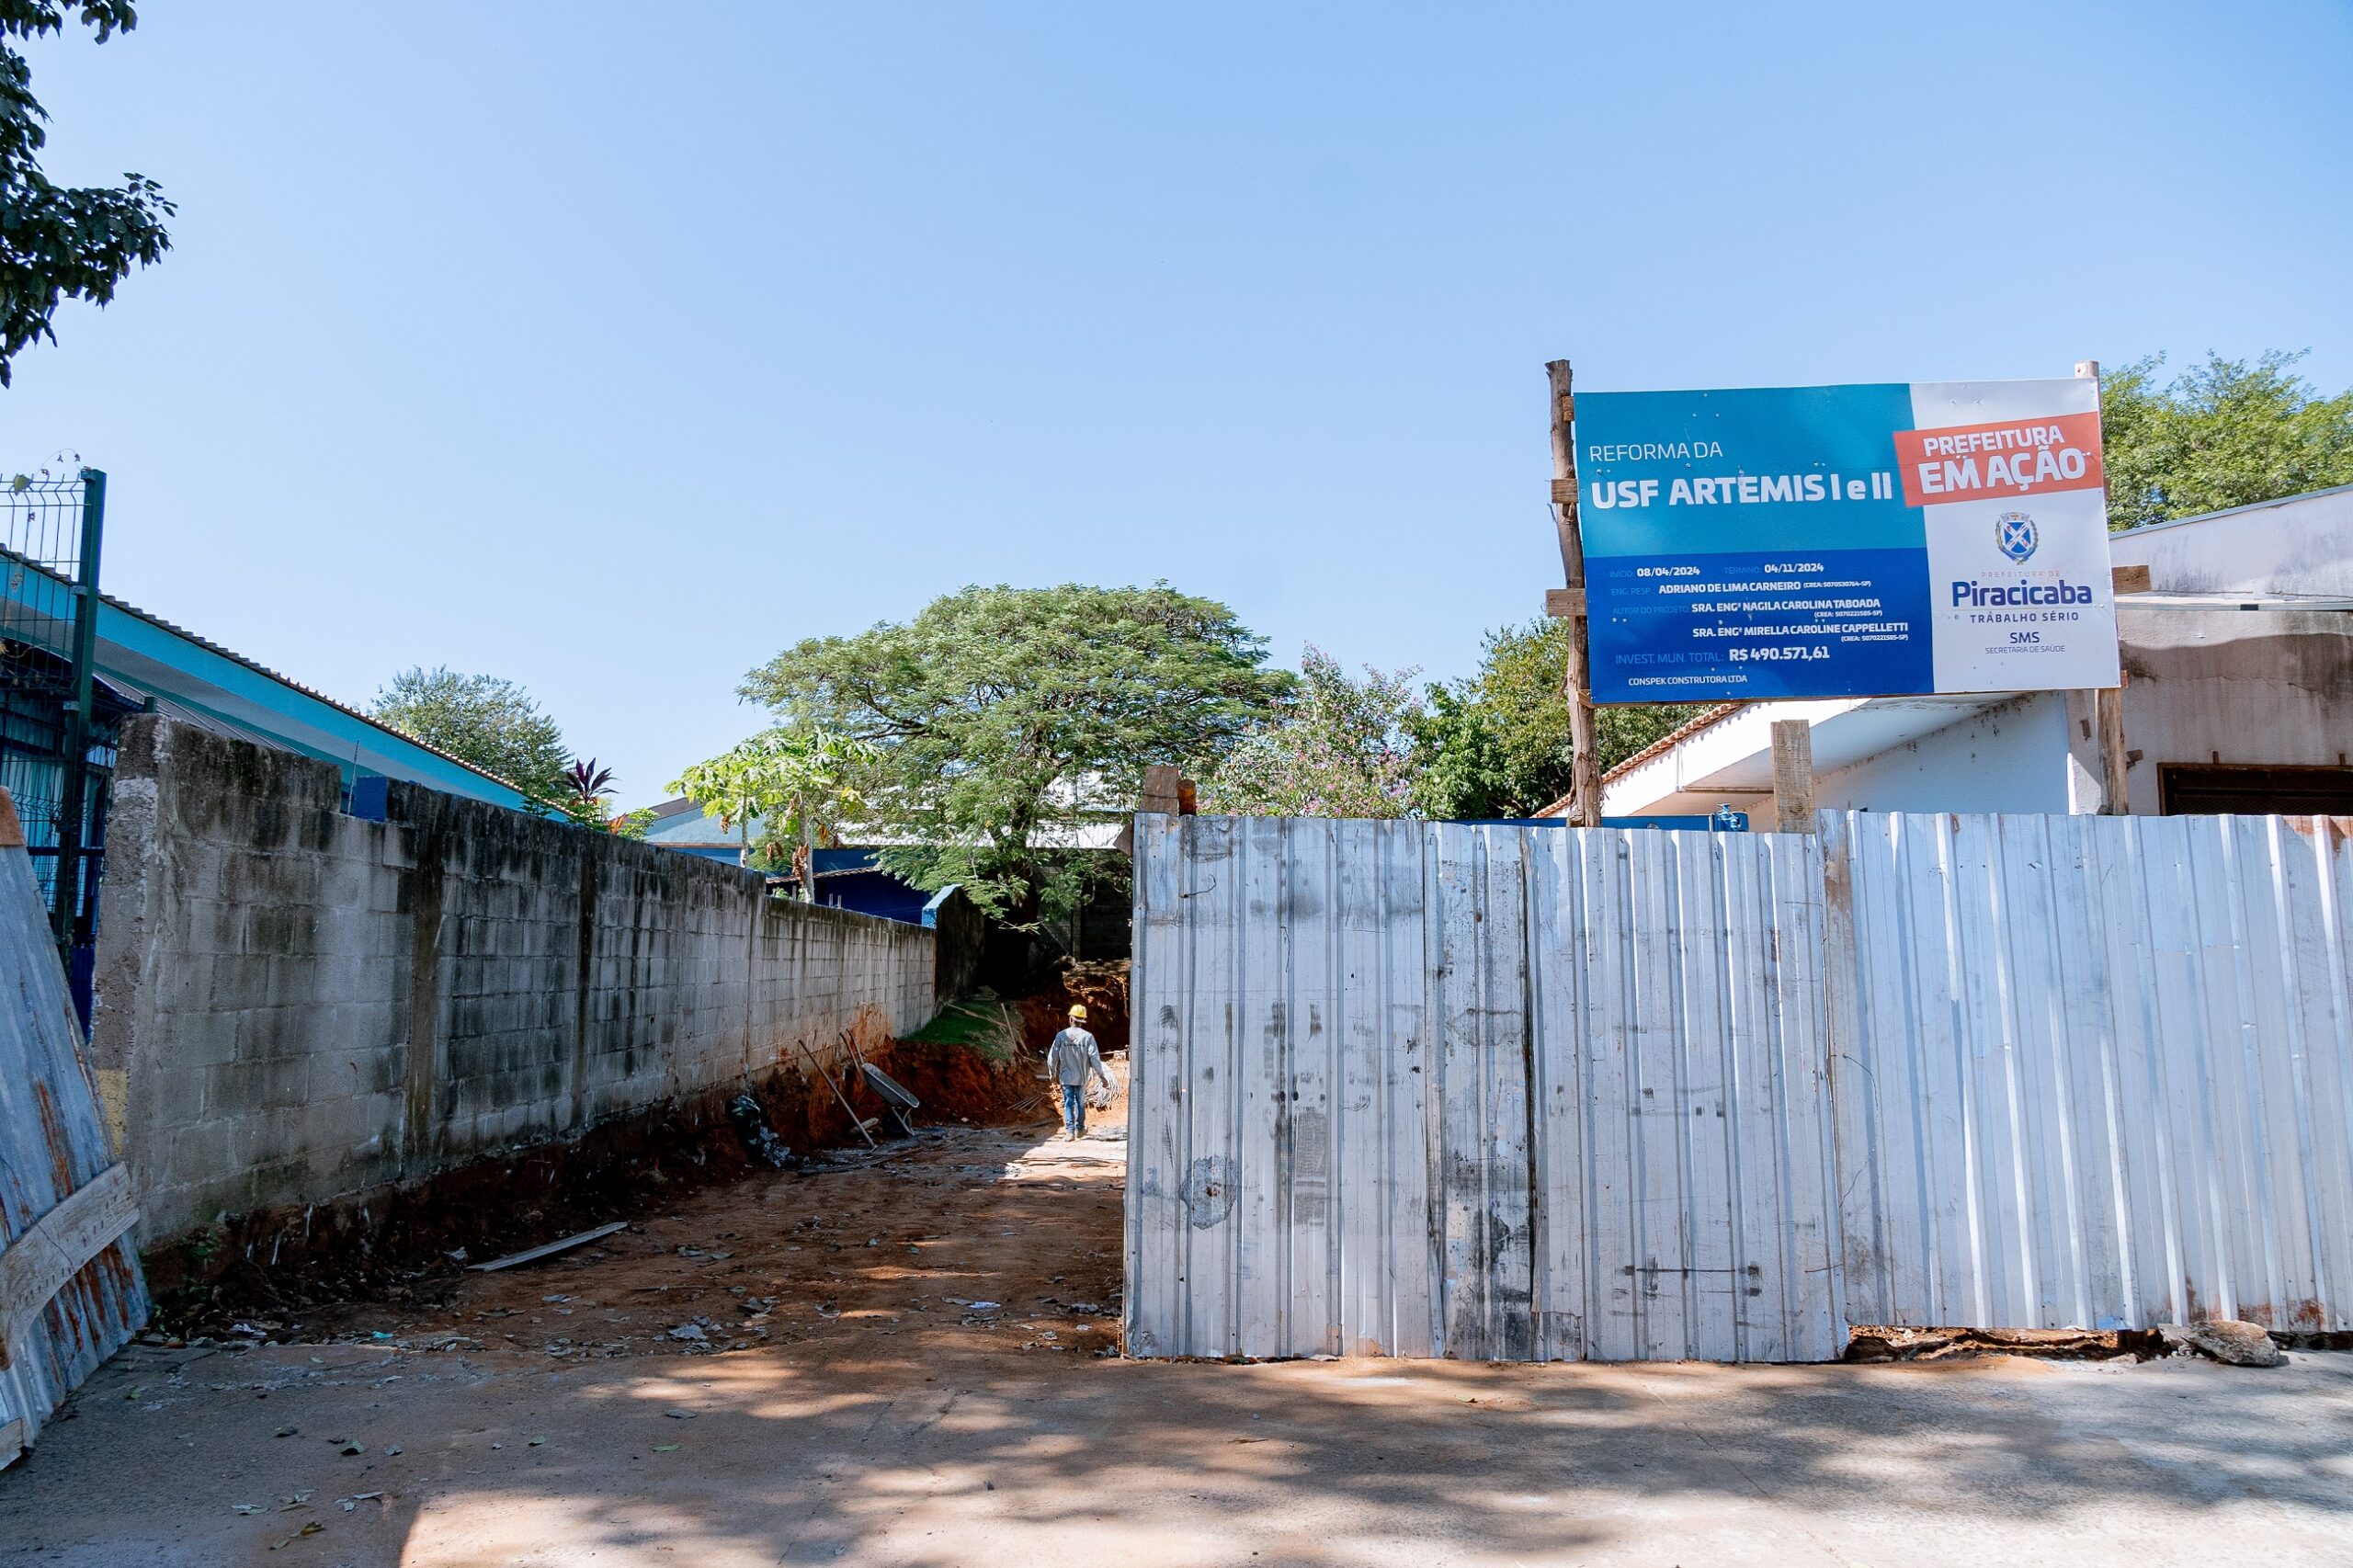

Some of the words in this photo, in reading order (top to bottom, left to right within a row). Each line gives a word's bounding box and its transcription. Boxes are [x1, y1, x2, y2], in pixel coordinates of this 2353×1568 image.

[1923, 426, 2065, 457] PREFEITURA
[1589, 442, 1690, 462] REFORMA
[1694, 441, 1723, 459] DA
[1917, 458, 1982, 494] EM
[1986, 444, 2086, 491] AÇÃO
[1591, 479, 1659, 509] USF
[1668, 474, 1825, 506] ARTEMIS
[1830, 473, 1841, 500] I
[1847, 480, 1866, 500] e
[1871, 472, 1893, 500] II
[1636, 565, 1700, 577] 08/04/2024
[1764, 562, 1824, 574] 04/11/2024
[1658, 584, 1706, 595] ADRIANO
[1707, 583, 1722, 593] DE
[1722, 582, 1749, 593] LIMA
[1749, 581, 1802, 592] CARNEIRO
[1951, 579, 2093, 607] Piracicaba
[1612, 606, 1639, 615] AUTOR
[1691, 603, 1715, 613] SRA.
[1743, 601, 1780, 611] NAGILA
[1782, 599, 1833, 609] CAROLINA
[1834, 598, 1881, 608] TABOADA
[1971, 613, 2037, 623] TRABALHO
[2041, 610, 2079, 621] SÉRIO
[1692, 627, 1717, 638] SRA.
[1744, 626, 1790, 636] MIRELLA
[1790, 624, 1841, 634] CAROLINE
[1842, 622, 1908, 632] CAPPELLETTI
[2009, 631, 2040, 643] SMS
[1615, 653, 1655, 665] INVEST.
[1657, 653, 1688, 664] MUN.
[1688, 652, 1724, 663] TOTAL:
[1729, 648, 1748, 663] R$
[1750, 645, 1830, 662] 490.571,61
[1984, 646, 2029, 654] SECRETARIA
[2029, 645, 2040, 653] DE
[2040, 644, 2065, 653] SAÚDE
[1628, 676, 1666, 686] CONSPEK
[1667, 676, 1728, 685] CONSTRUTORA
[1728, 675, 1747, 684] LTDA
